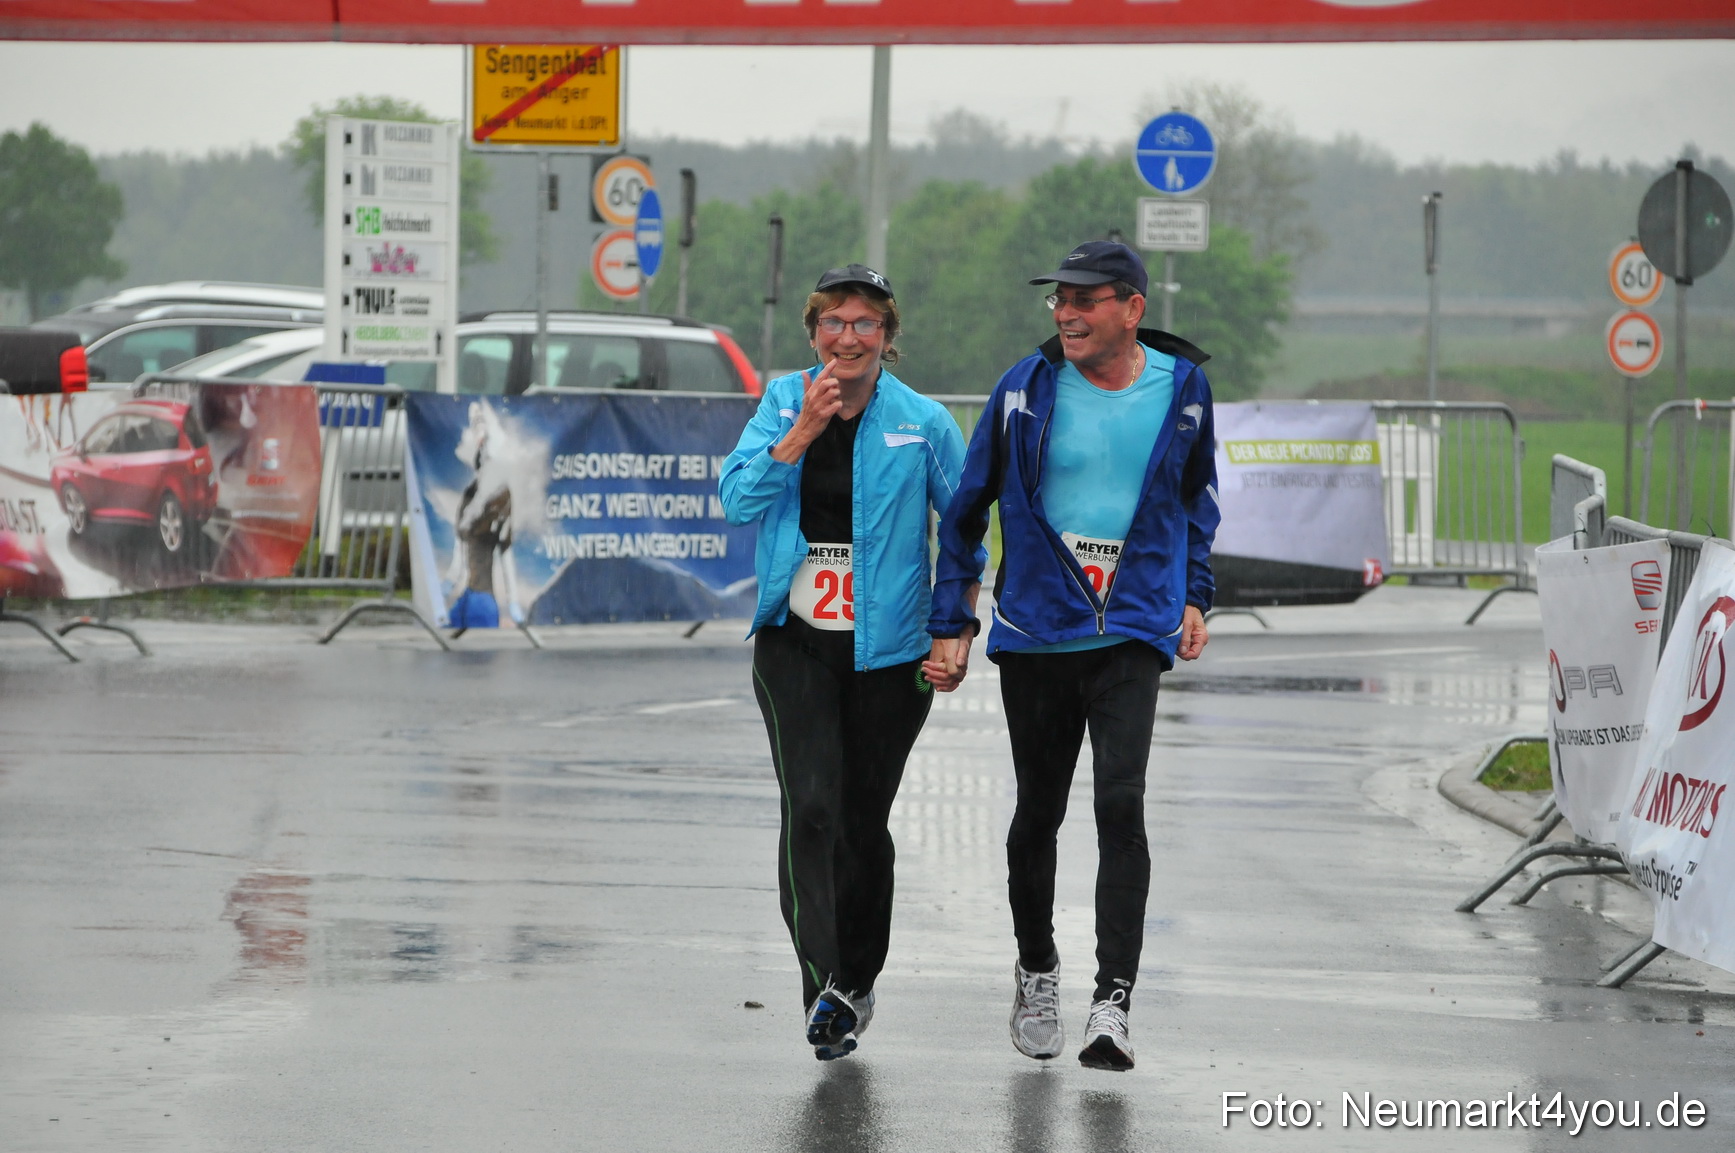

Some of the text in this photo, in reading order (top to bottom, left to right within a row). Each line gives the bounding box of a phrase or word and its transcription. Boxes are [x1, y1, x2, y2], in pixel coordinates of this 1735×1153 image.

[486, 48, 606, 81] Sengenthal
[609, 176, 642, 207] 60
[1623, 260, 1652, 289] 60
[1231, 443, 1257, 462] DER
[1258, 443, 1290, 462] NEUE
[1290, 442, 1334, 462] PICANTO
[552, 452, 675, 480] SAISONSTART
[678, 455, 706, 480] BEI
[546, 492, 602, 519] GANZ
[543, 531, 727, 559] WINTERANGEBOTEN
[807, 547, 850, 558] MEYER
[1075, 540, 1119, 555] MEYER
[1075, 551, 1118, 563] WERBUNG
[807, 557, 850, 566] WERBUNG
[1594, 727, 1611, 745] IST
[1611, 724, 1631, 744] DAS
[1646, 771, 1727, 839] MOTORS
